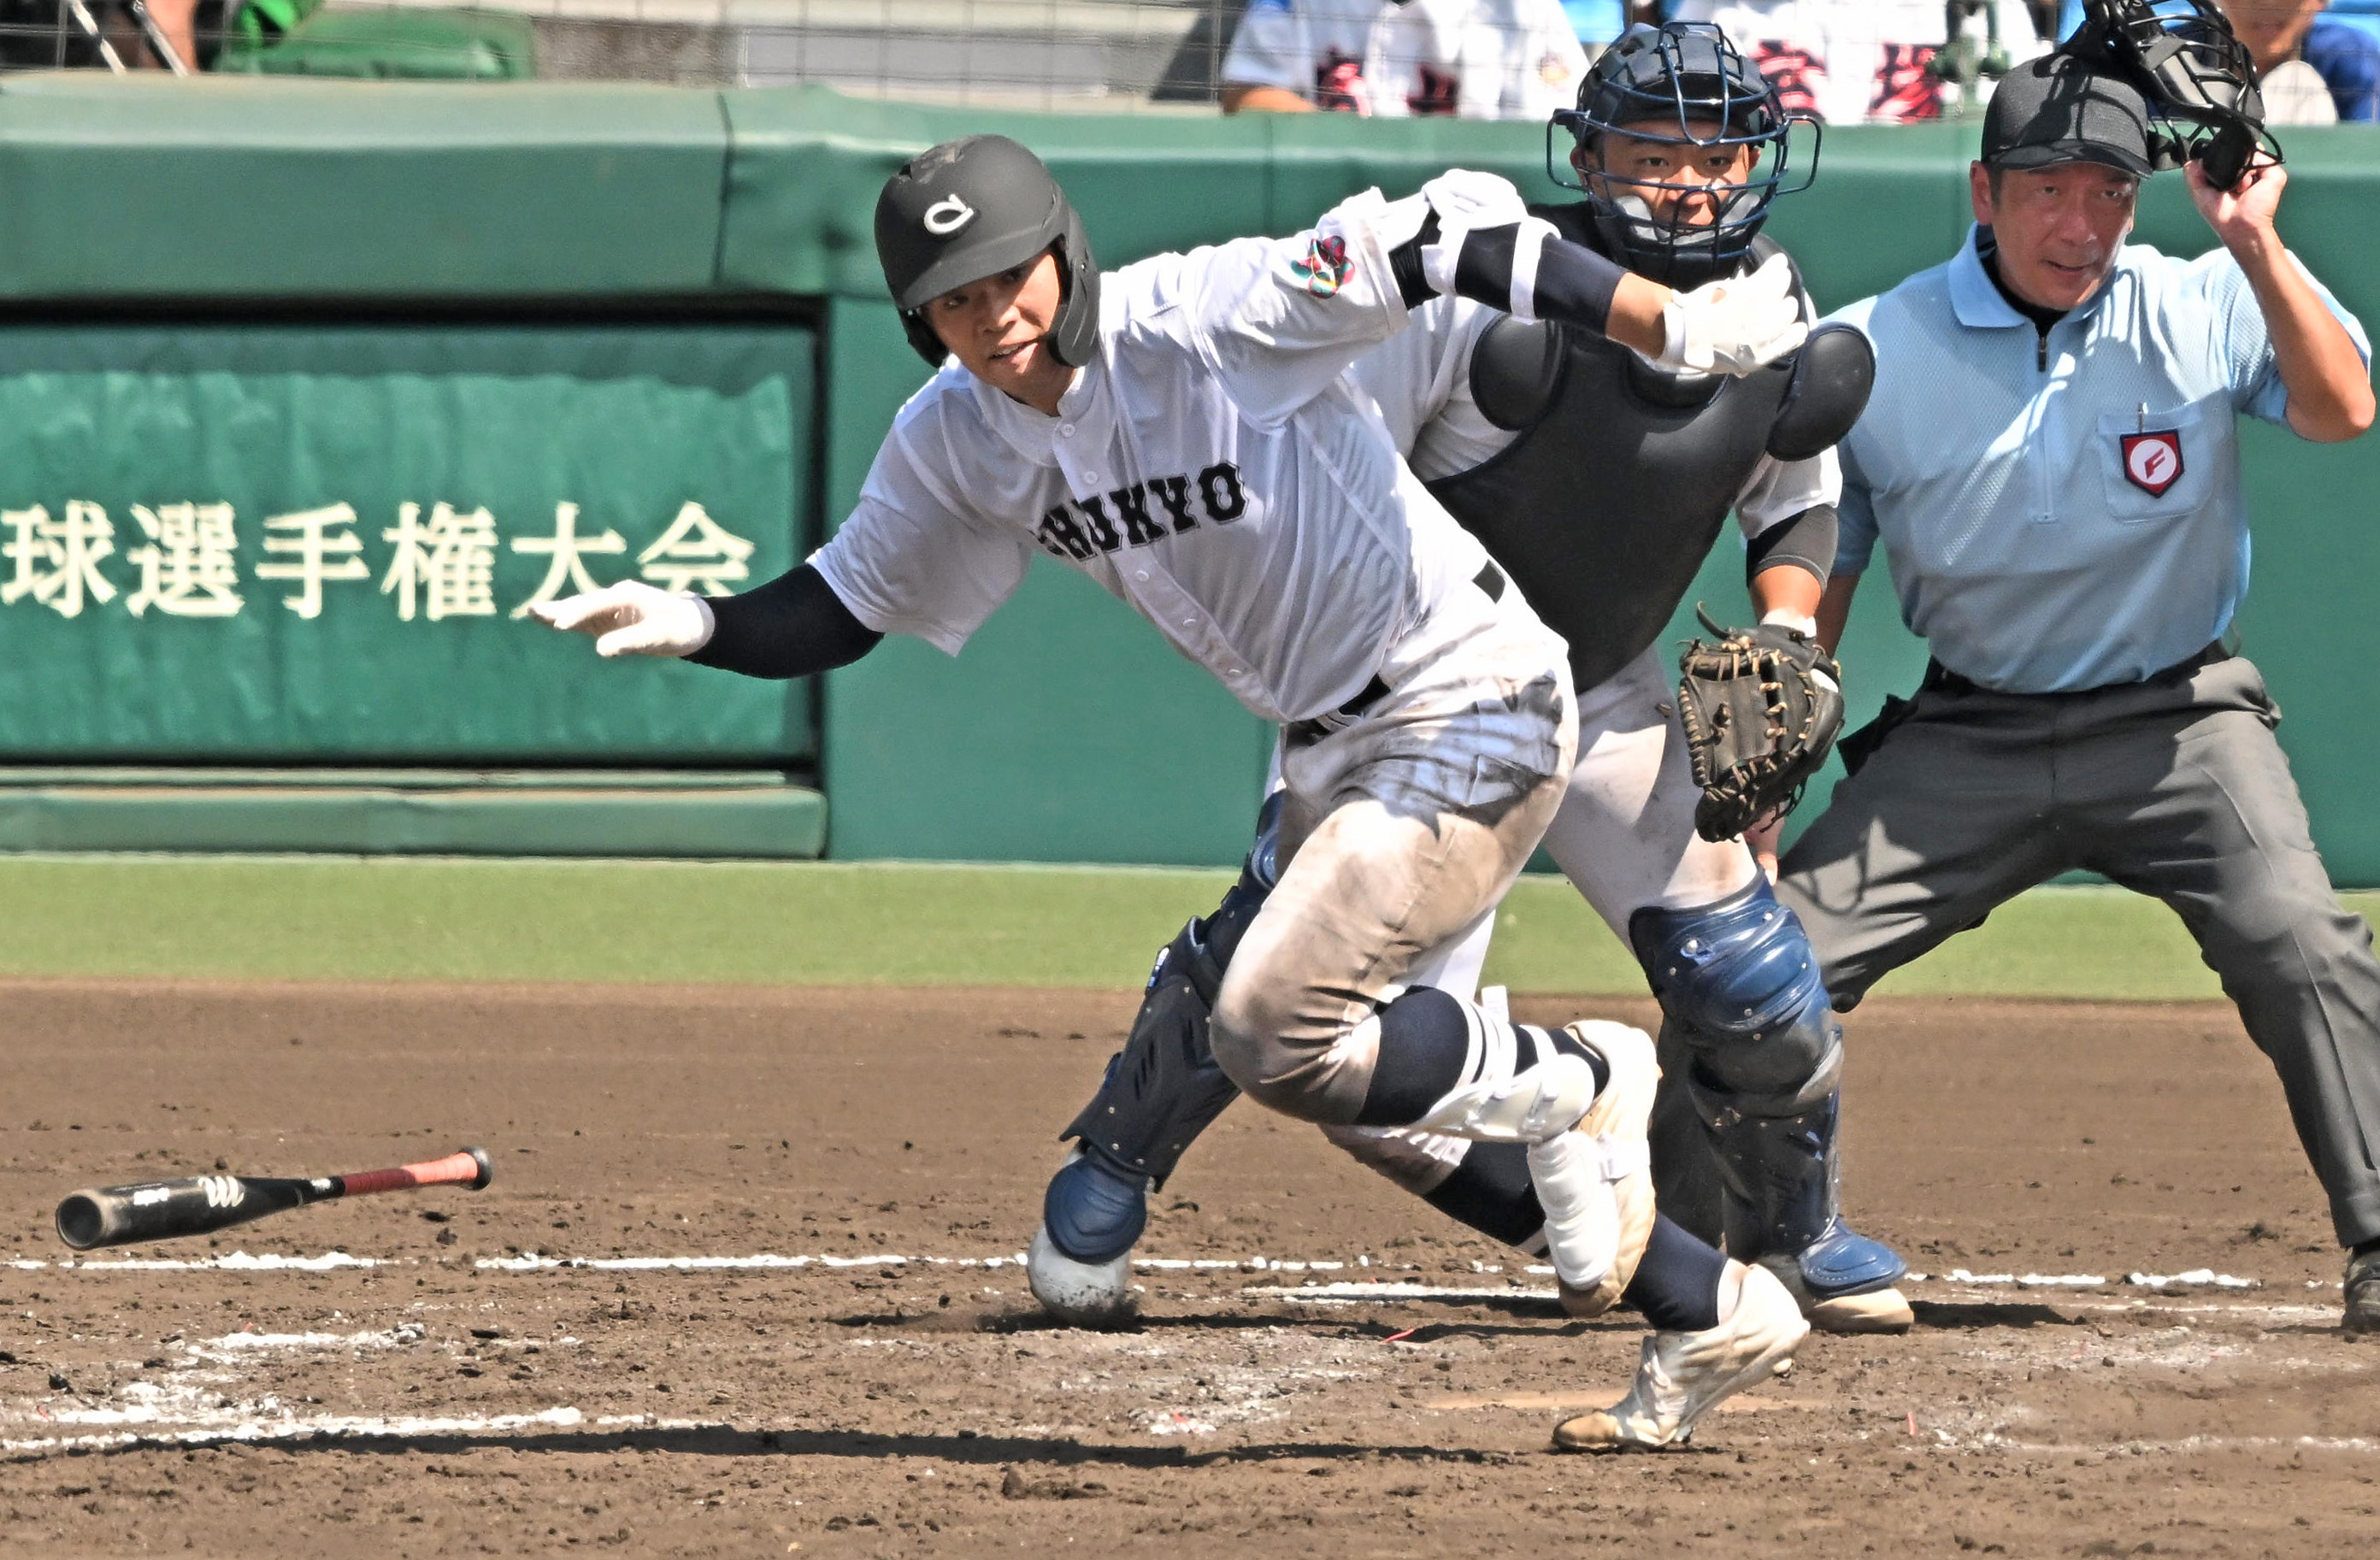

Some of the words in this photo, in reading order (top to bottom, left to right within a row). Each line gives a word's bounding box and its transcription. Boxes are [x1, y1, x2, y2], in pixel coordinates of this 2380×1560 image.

[2, 500, 756, 621] 球選手権大会
[1033, 461, 1248, 562] HUKYO
